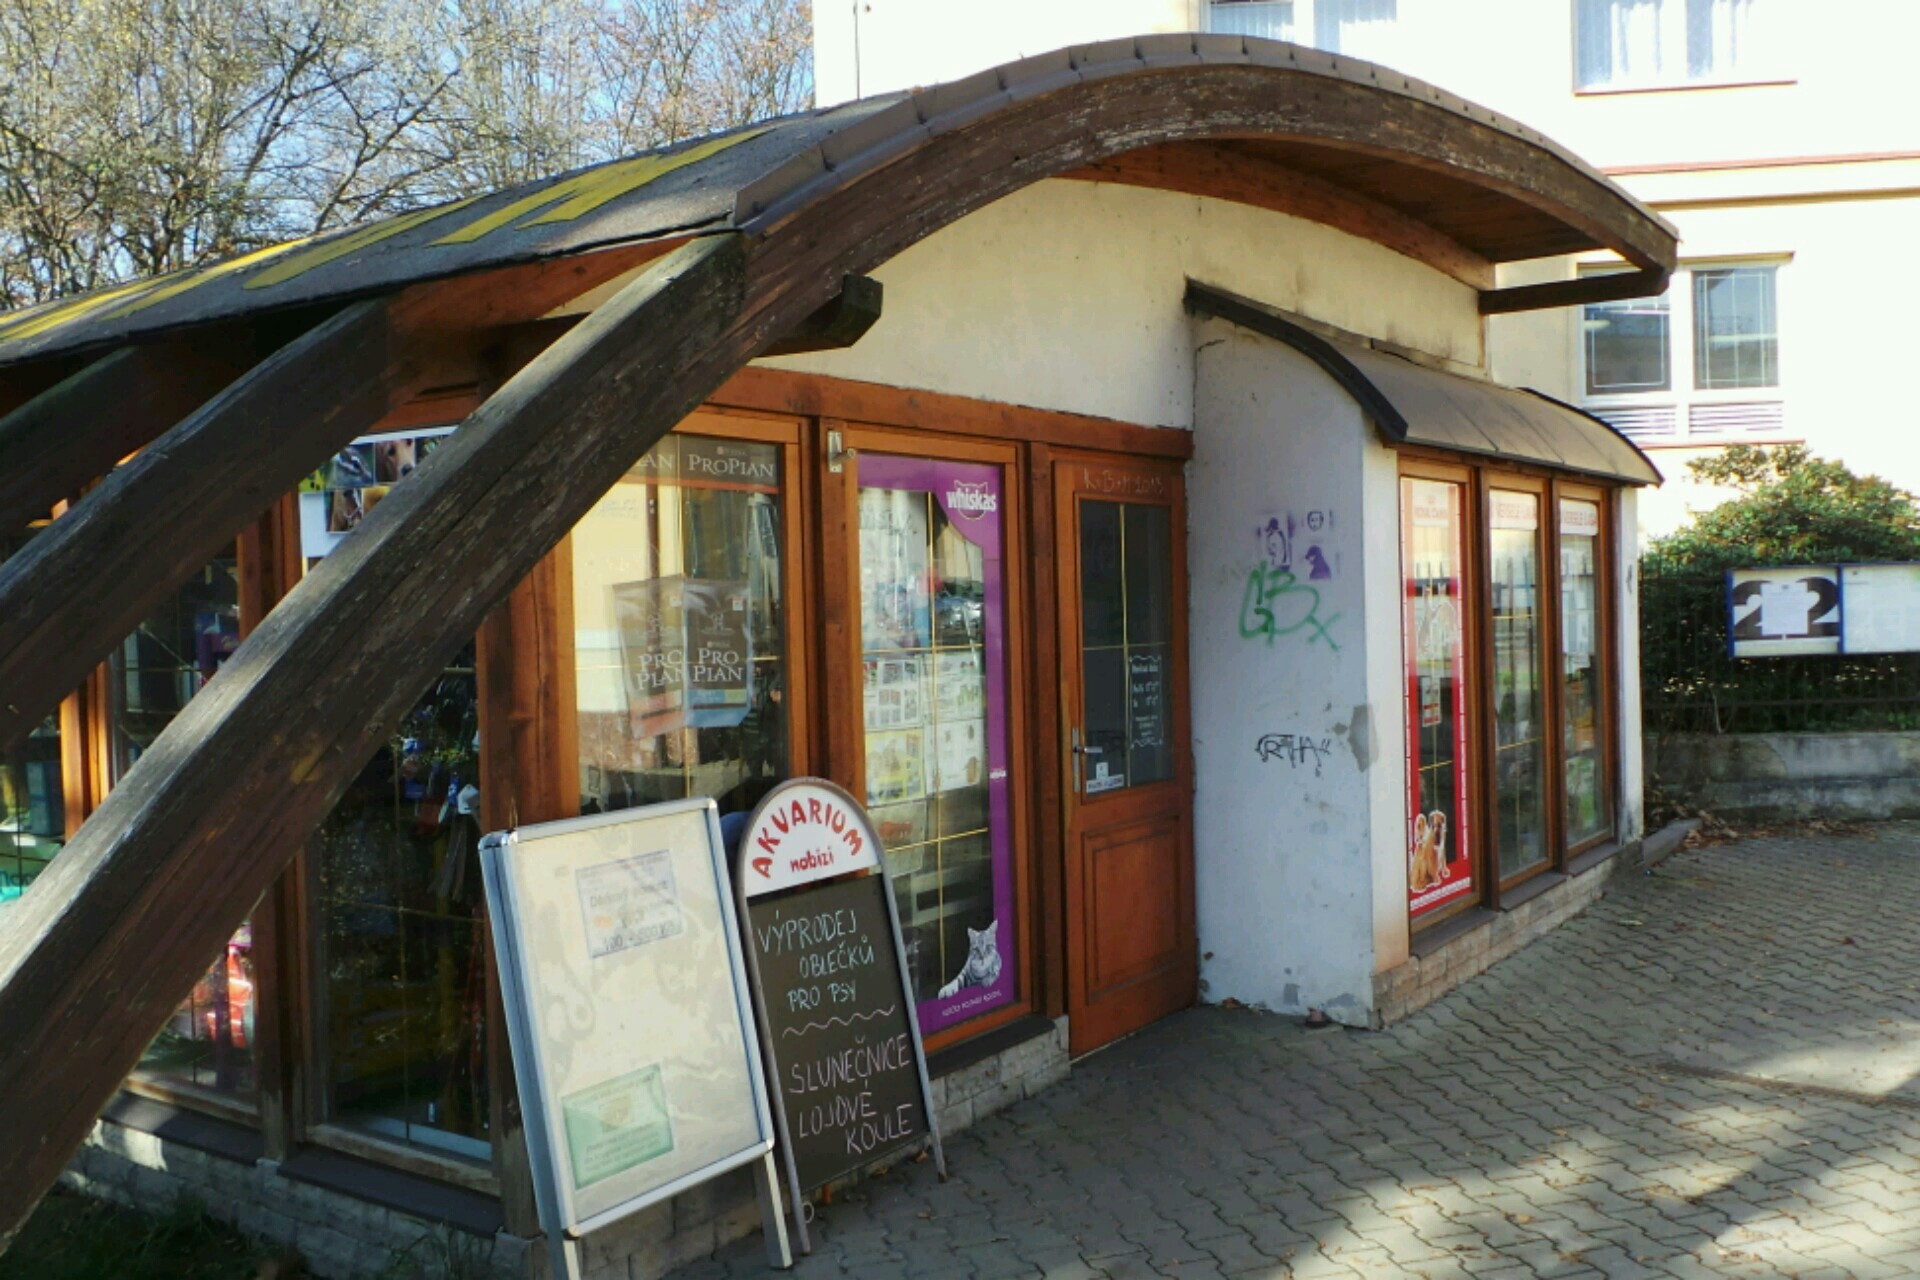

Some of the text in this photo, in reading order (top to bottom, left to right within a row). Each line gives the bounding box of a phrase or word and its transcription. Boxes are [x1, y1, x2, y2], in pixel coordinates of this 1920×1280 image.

[946, 487, 997, 513] whiskas
[692, 665, 744, 683] PLAN
[698, 648, 740, 669] PRO
[751, 797, 863, 879] AKVARIUM
[757, 908, 857, 956] VÝPRODEJ
[786, 980, 856, 1012] PRO PSY
[788, 1032, 910, 1094] SLUNEČNICE
[799, 1078, 878, 1139] LOJOVÉ
[845, 1102, 913, 1155] KOULE
